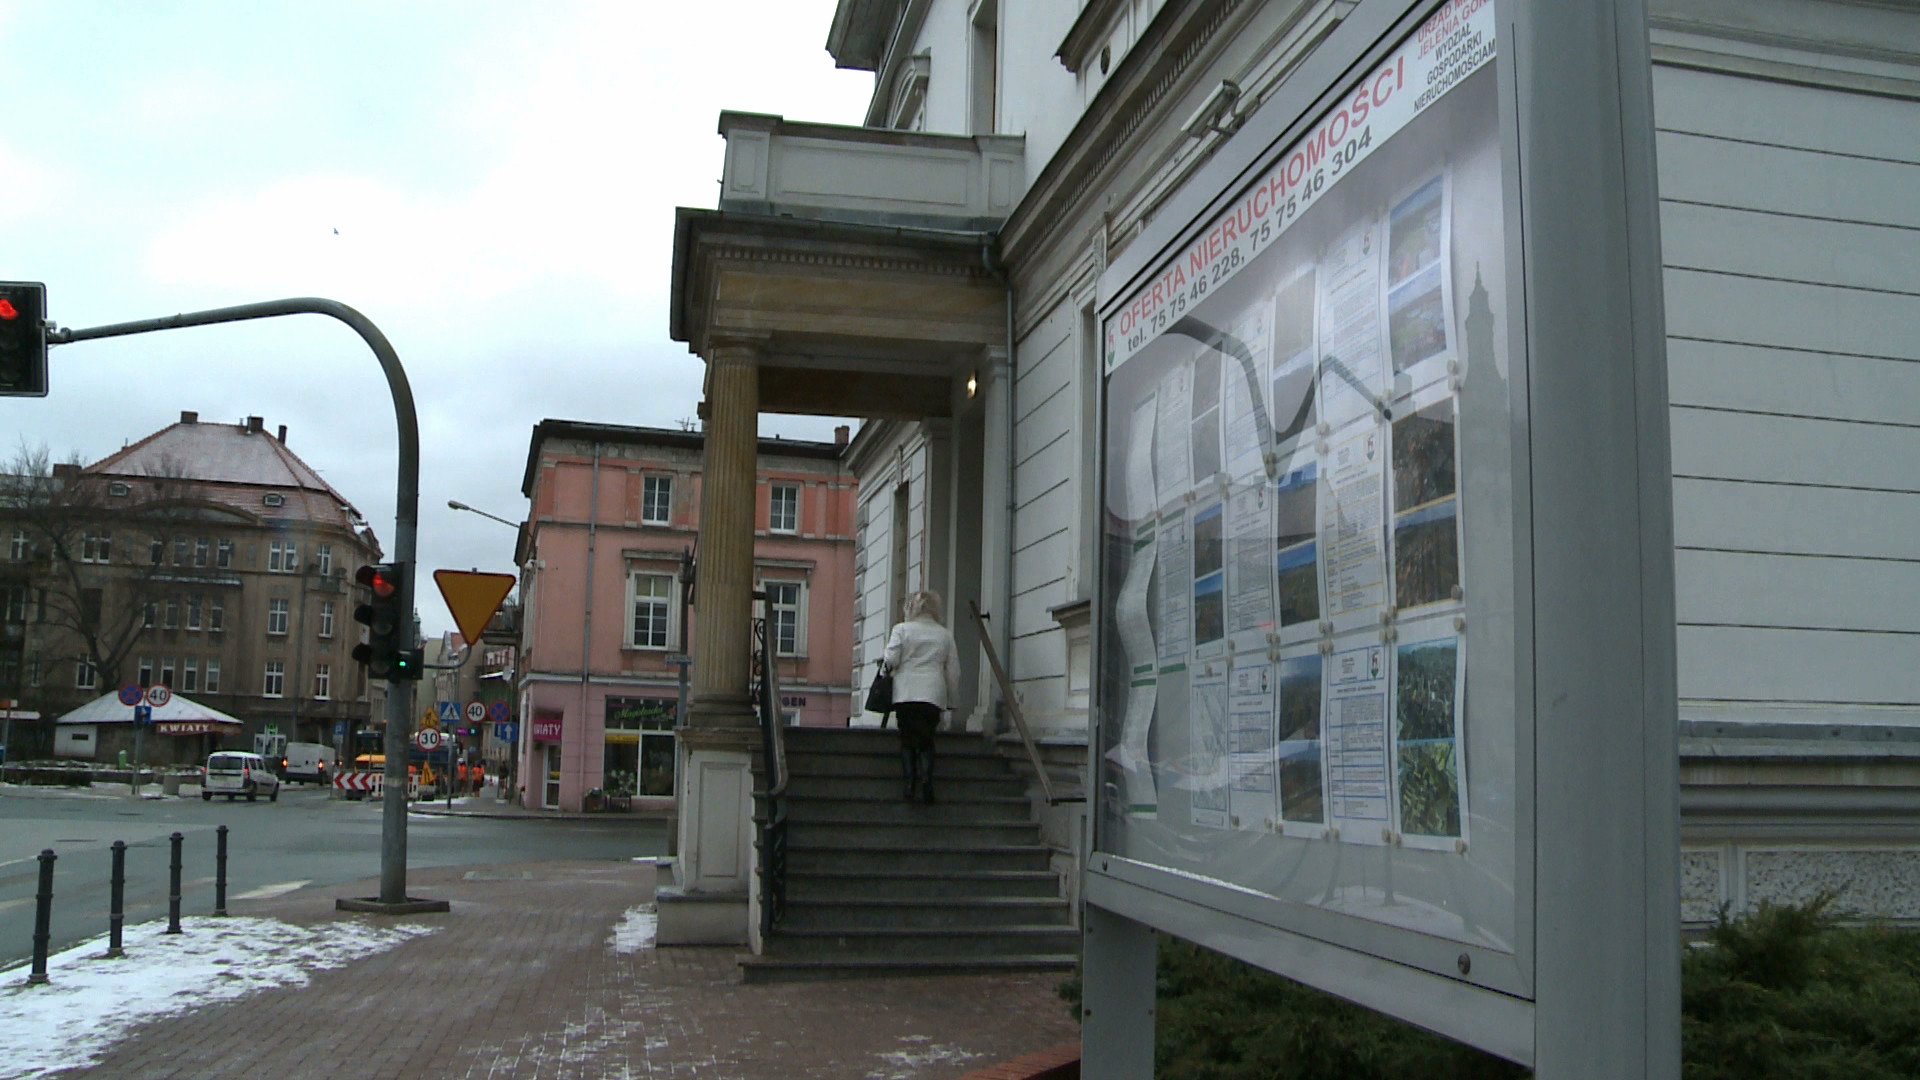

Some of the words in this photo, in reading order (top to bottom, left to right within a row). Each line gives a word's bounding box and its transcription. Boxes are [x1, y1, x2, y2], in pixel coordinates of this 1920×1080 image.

[1417, 15, 1460, 60] JELENIA
[1435, 22, 1472, 61] WYDZIAŁ
[1426, 30, 1482, 85] GOSPODARKI
[1120, 263, 1186, 336] OFERTA
[1188, 56, 1404, 278] NIERUCHOMOŚCI
[1128, 327, 1147, 352] tel.
[1151, 309, 1166, 334] 75
[1169, 292, 1186, 318] 75
[1190, 275, 1207, 300] 46
[1211, 247, 1245, 285] 228,
[1250, 219, 1271, 252] 75
[1275, 195, 1296, 229] 75
[1302, 168, 1324, 202] 46
[1331, 124, 1372, 176] 304
[149, 689, 167, 701] 40
[468, 706, 483, 717] 40
[160, 723, 210, 733] KWIATY
[421, 732, 438, 745] 30
